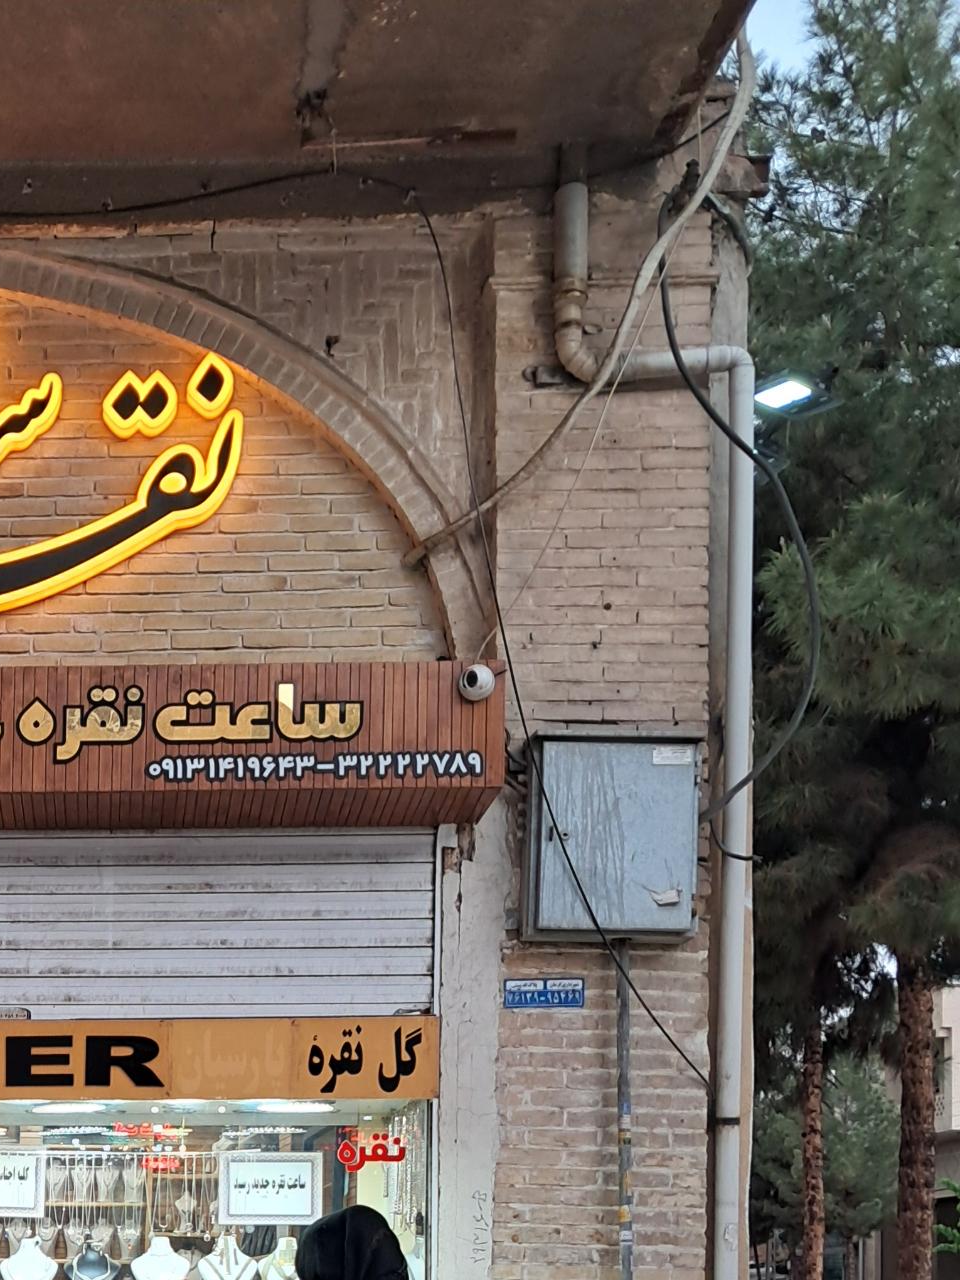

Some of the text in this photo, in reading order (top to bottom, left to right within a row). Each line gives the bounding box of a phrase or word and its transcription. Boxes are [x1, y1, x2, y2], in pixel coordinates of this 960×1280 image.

[154, 682, 364, 743] ساعت
[377, 1025, 423, 1093] گل
[337, 1132, 407, 1173] نقره
[271, 1174, 286, 1195] نقره
[286, 1173, 306, 1190] ساعت
